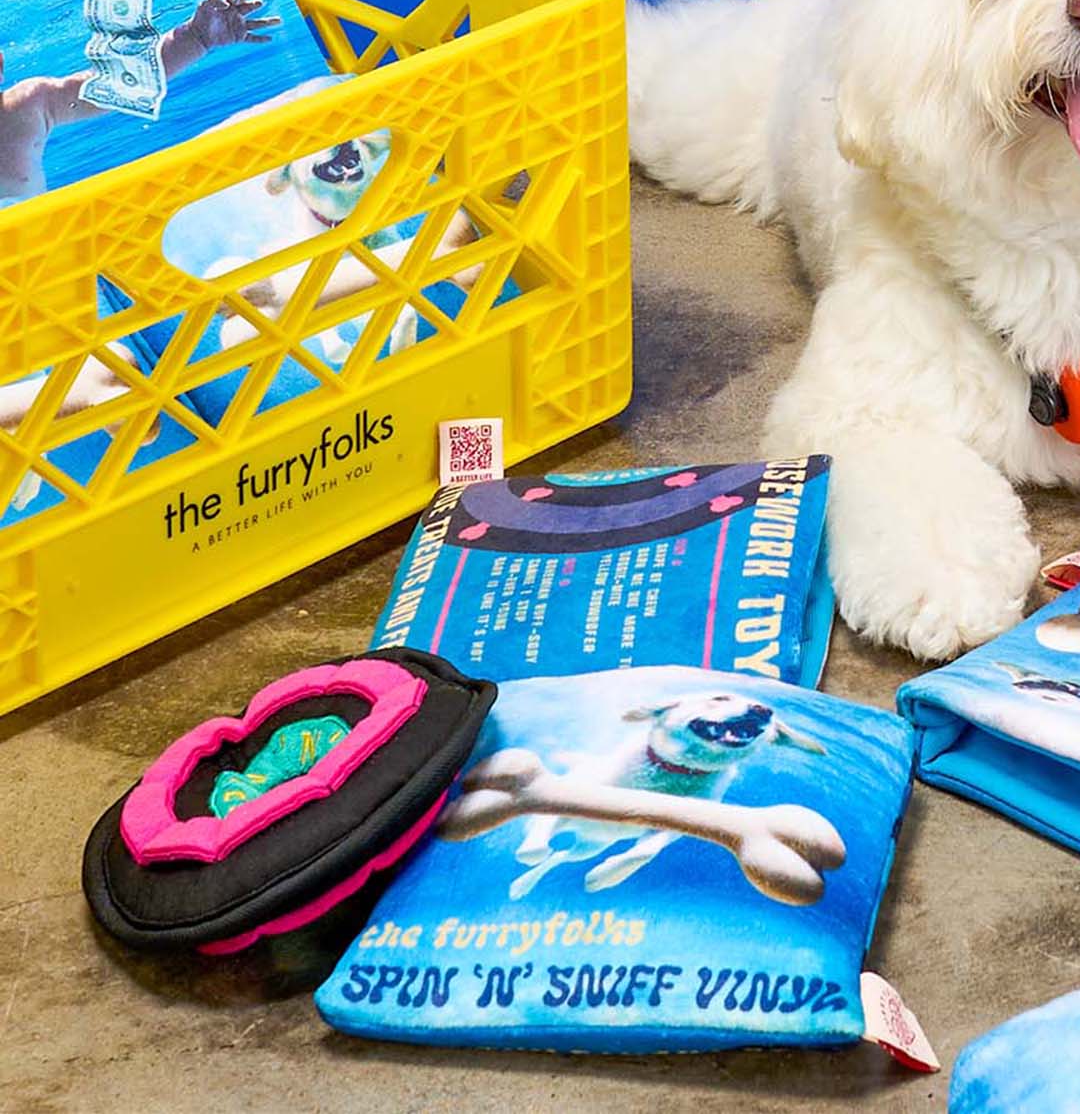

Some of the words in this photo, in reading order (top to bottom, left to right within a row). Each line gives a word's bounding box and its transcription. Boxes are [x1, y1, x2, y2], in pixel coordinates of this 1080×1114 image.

[162, 490, 223, 539] the
[235, 408, 396, 506] furryfolks
[191, 541, 201, 554] A
[207, 513, 260, 548] BETTER
[266, 497, 295, 521] LIFE
[301, 477, 339, 504] WITH
[345, 462, 375, 484] YOU
[742, 457, 809, 579] OSEWORK
[401, 515, 452, 591] TREATS
[594, 553, 613, 586] YELLOW
[384, 585, 426, 631] AND
[492, 600, 512, 631] YOUNG
[582, 588, 605, 654] SUBWOOFER
[643, 588, 660, 618] CHEW
[621, 614, 637, 649] MORE
[733, 592, 785, 680] TOY
[356, 920, 424, 951] the
[432, 909, 647, 957] furryfolks
[342, 963, 460, 1009] SPIN
[541, 964, 683, 1011] SNIFF
[695, 966, 849, 1015] VINYL
